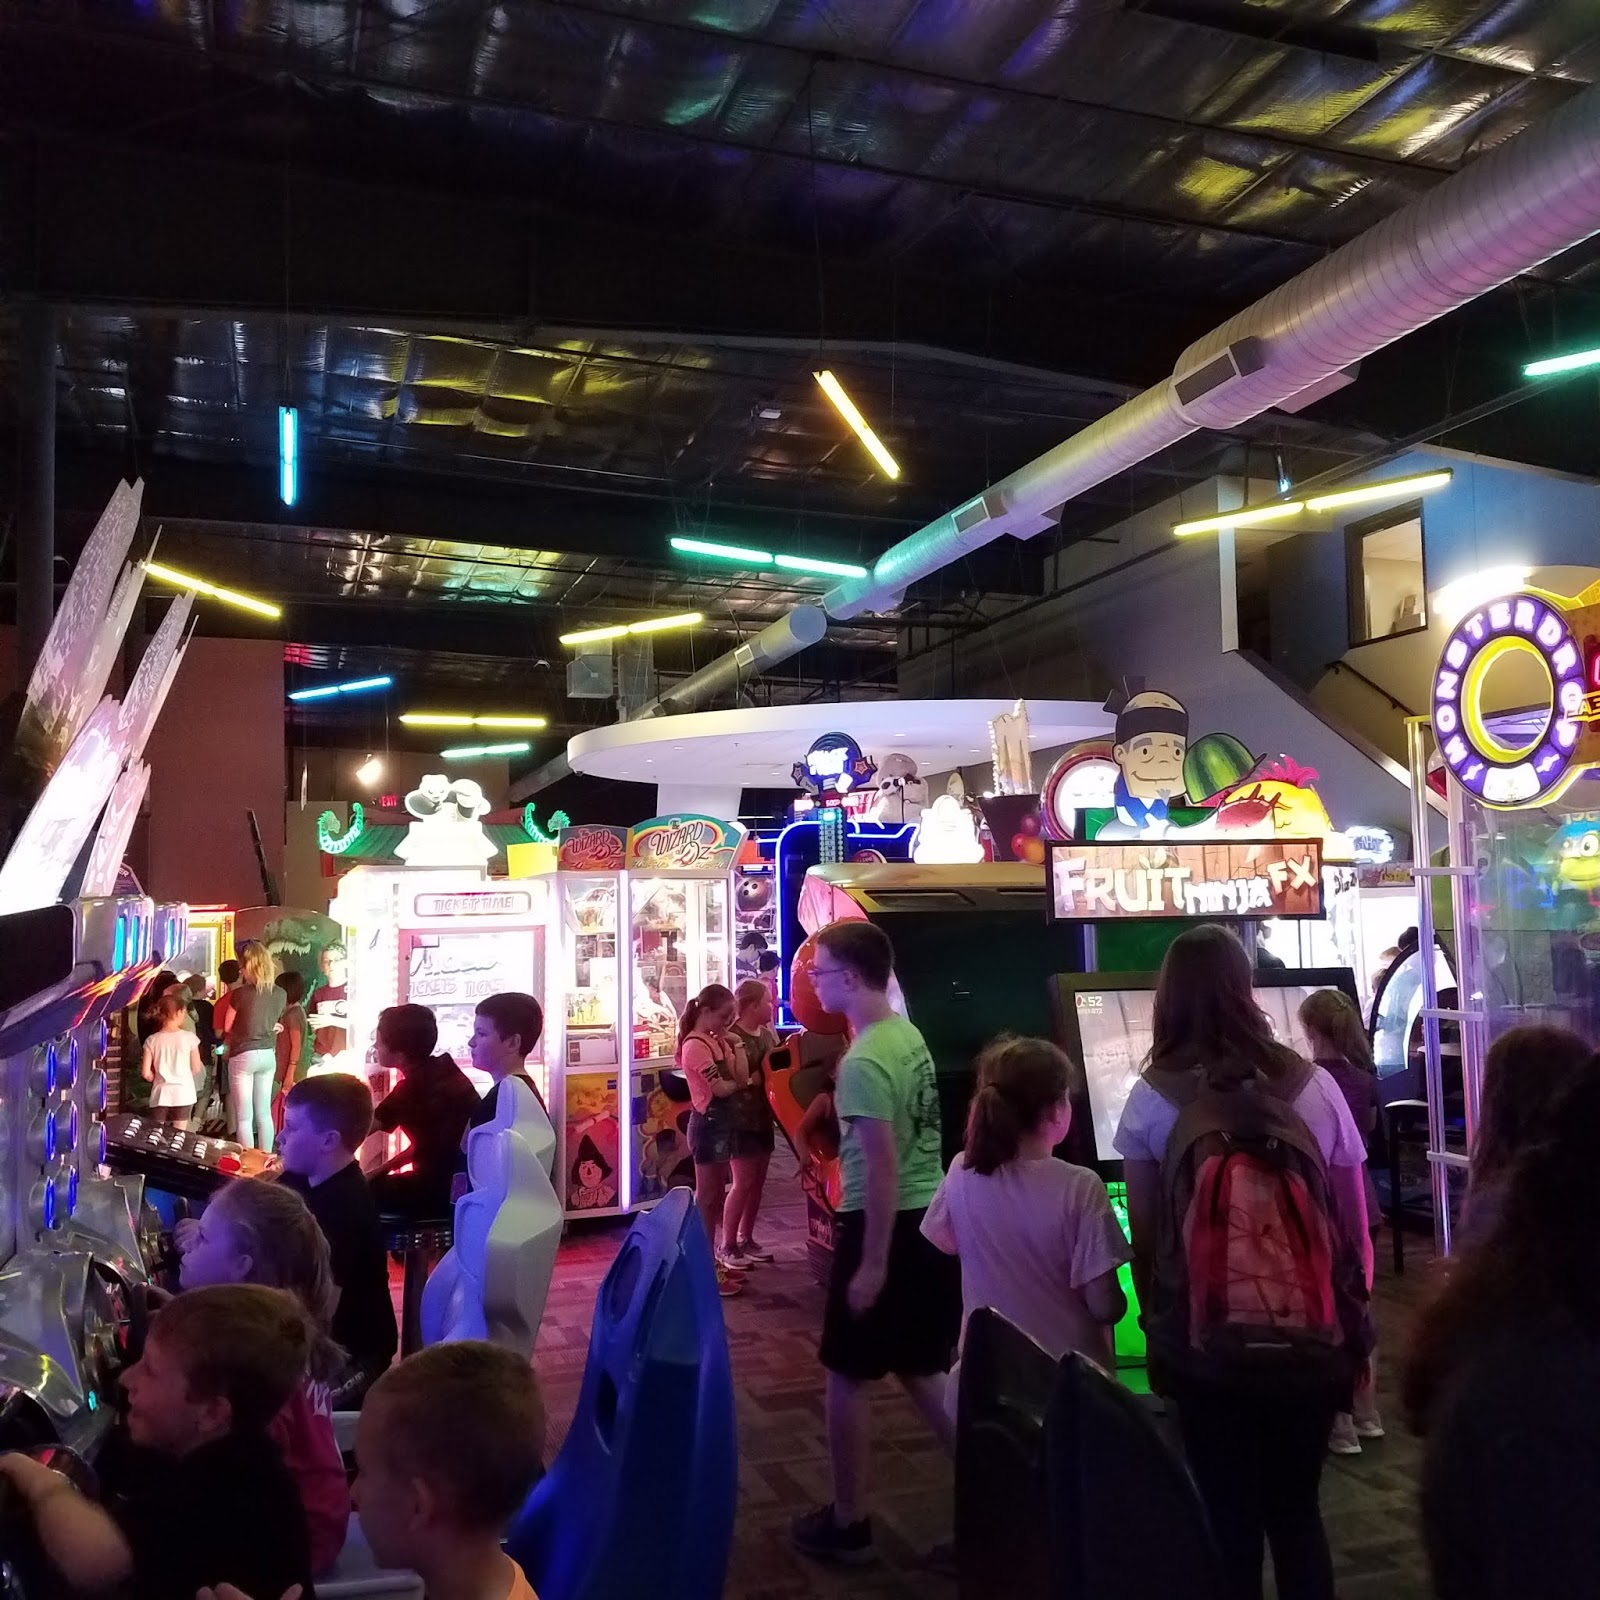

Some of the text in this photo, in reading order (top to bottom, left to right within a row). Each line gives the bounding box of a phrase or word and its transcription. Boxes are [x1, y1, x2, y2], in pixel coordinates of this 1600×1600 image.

[1435, 599, 1536, 765] MONSTER
[381, 796, 397, 807] EXIT
[566, 831, 611, 854] WIZARD
[650, 822, 704, 856] WIZARD
[1054, 856, 1191, 912] FRUIT
[1266, 854, 1317, 895] FX
[433, 897, 480, 912] TICKET
[409, 977, 457, 997] ICKETS
[1087, 995, 1103, 1007] 52
